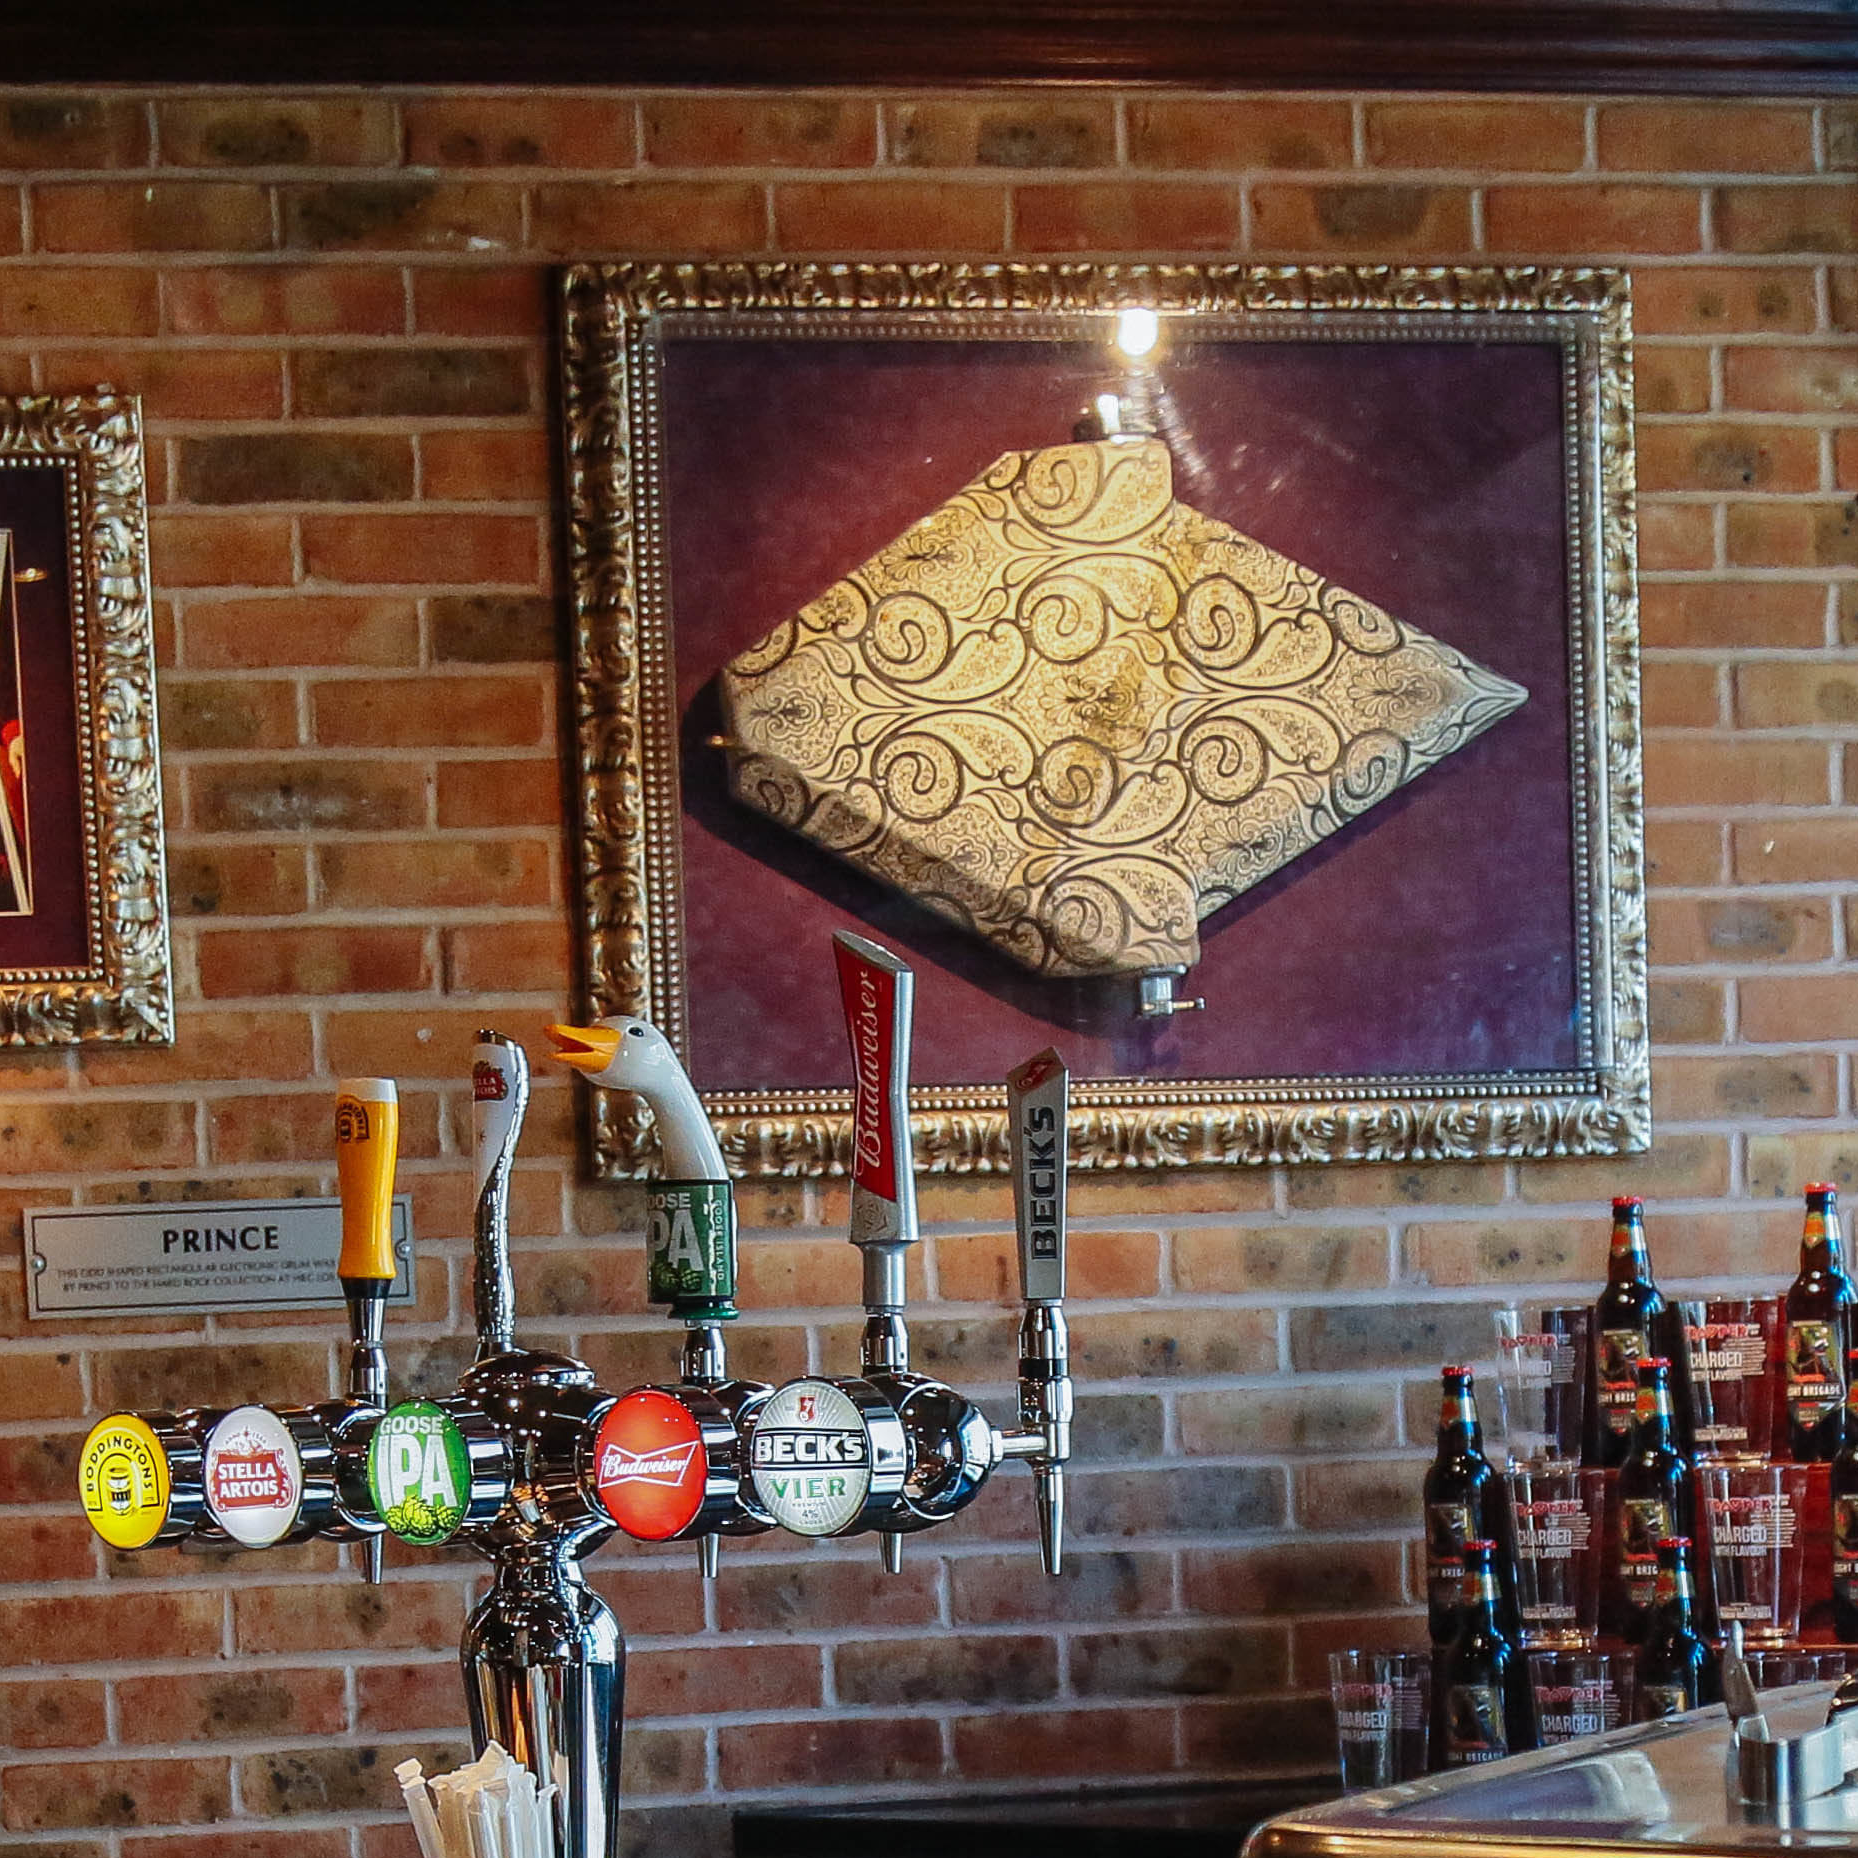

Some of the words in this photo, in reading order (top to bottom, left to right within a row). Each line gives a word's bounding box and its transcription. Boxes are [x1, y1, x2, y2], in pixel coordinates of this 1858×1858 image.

[854, 971, 883, 1178] Budweiser
[1023, 1107, 1058, 1261] BECK'S
[646, 1192, 692, 1209] OOSE
[162, 1225, 280, 1254] PRINCE
[647, 1209, 705, 1271] PA
[379, 1415, 442, 1435] GOOSE
[755, 1431, 865, 1463] BECK'S
[86, 1435, 153, 1492] BODDINGTONS
[218, 1462, 277, 1480] STELLA
[378, 1435, 458, 1511] IPA
[602, 1454, 689, 1479] Budweiser
[219, 1480, 279, 1498] ARTOIS
[768, 1475, 848, 1500] VIER
